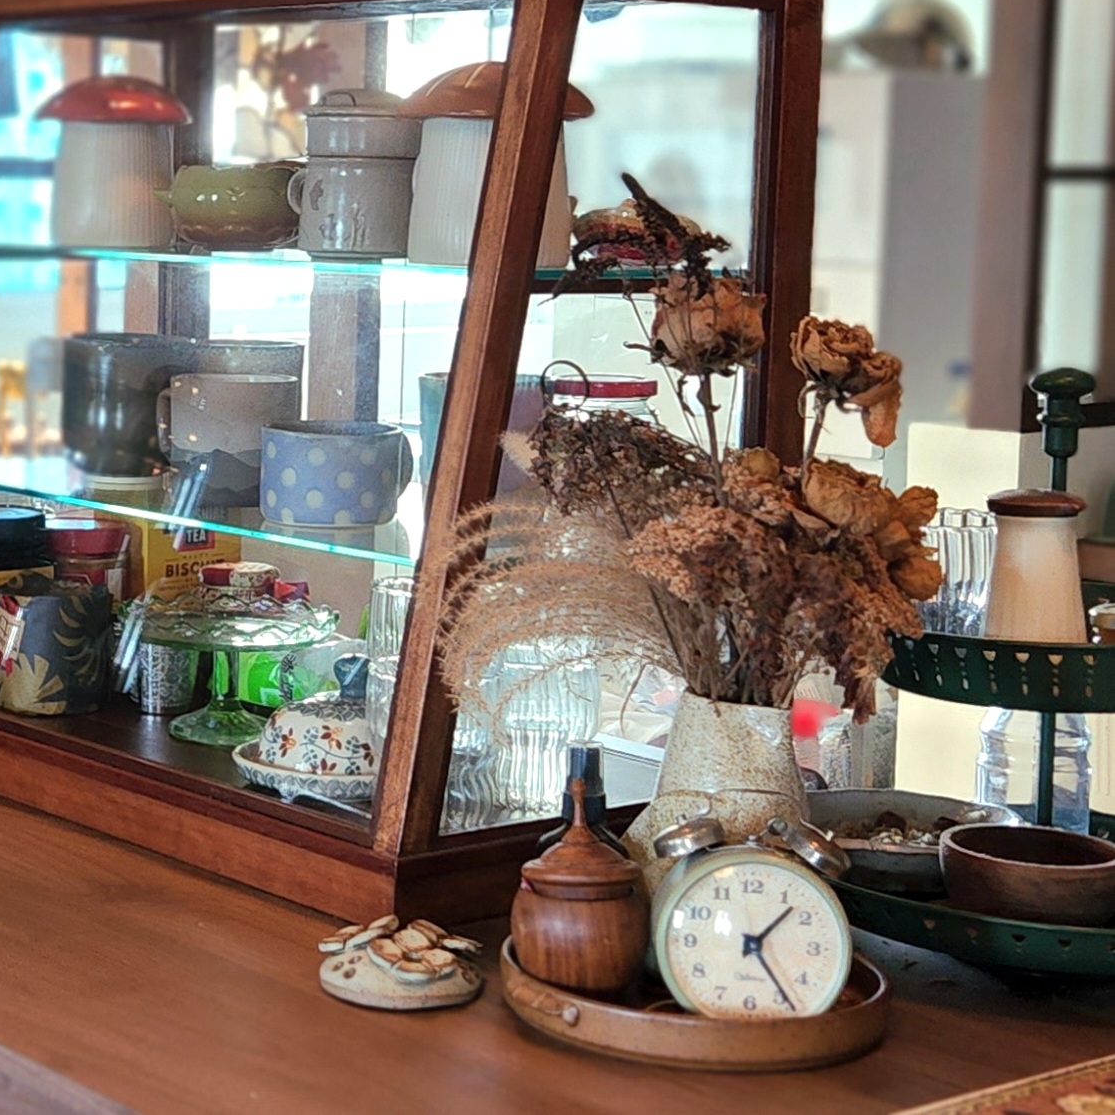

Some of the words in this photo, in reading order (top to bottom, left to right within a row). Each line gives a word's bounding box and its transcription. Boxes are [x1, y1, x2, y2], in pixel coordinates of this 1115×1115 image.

[186, 528, 207, 543] TEA
[741, 878, 765, 894] 12
[713, 887, 730, 901] 11
[780, 890, 789, 905] 1
[690, 905, 712, 921] 10
[798, 911, 813, 926] 2
[683, 934, 698, 948] 9
[806, 942, 821, 957] 3
[692, 963, 706, 978] 8
[794, 971, 809, 985] 4
[714, 986, 727, 1001] 7
[773, 990, 787, 1005] 5
[743, 995, 757, 1011] 6
